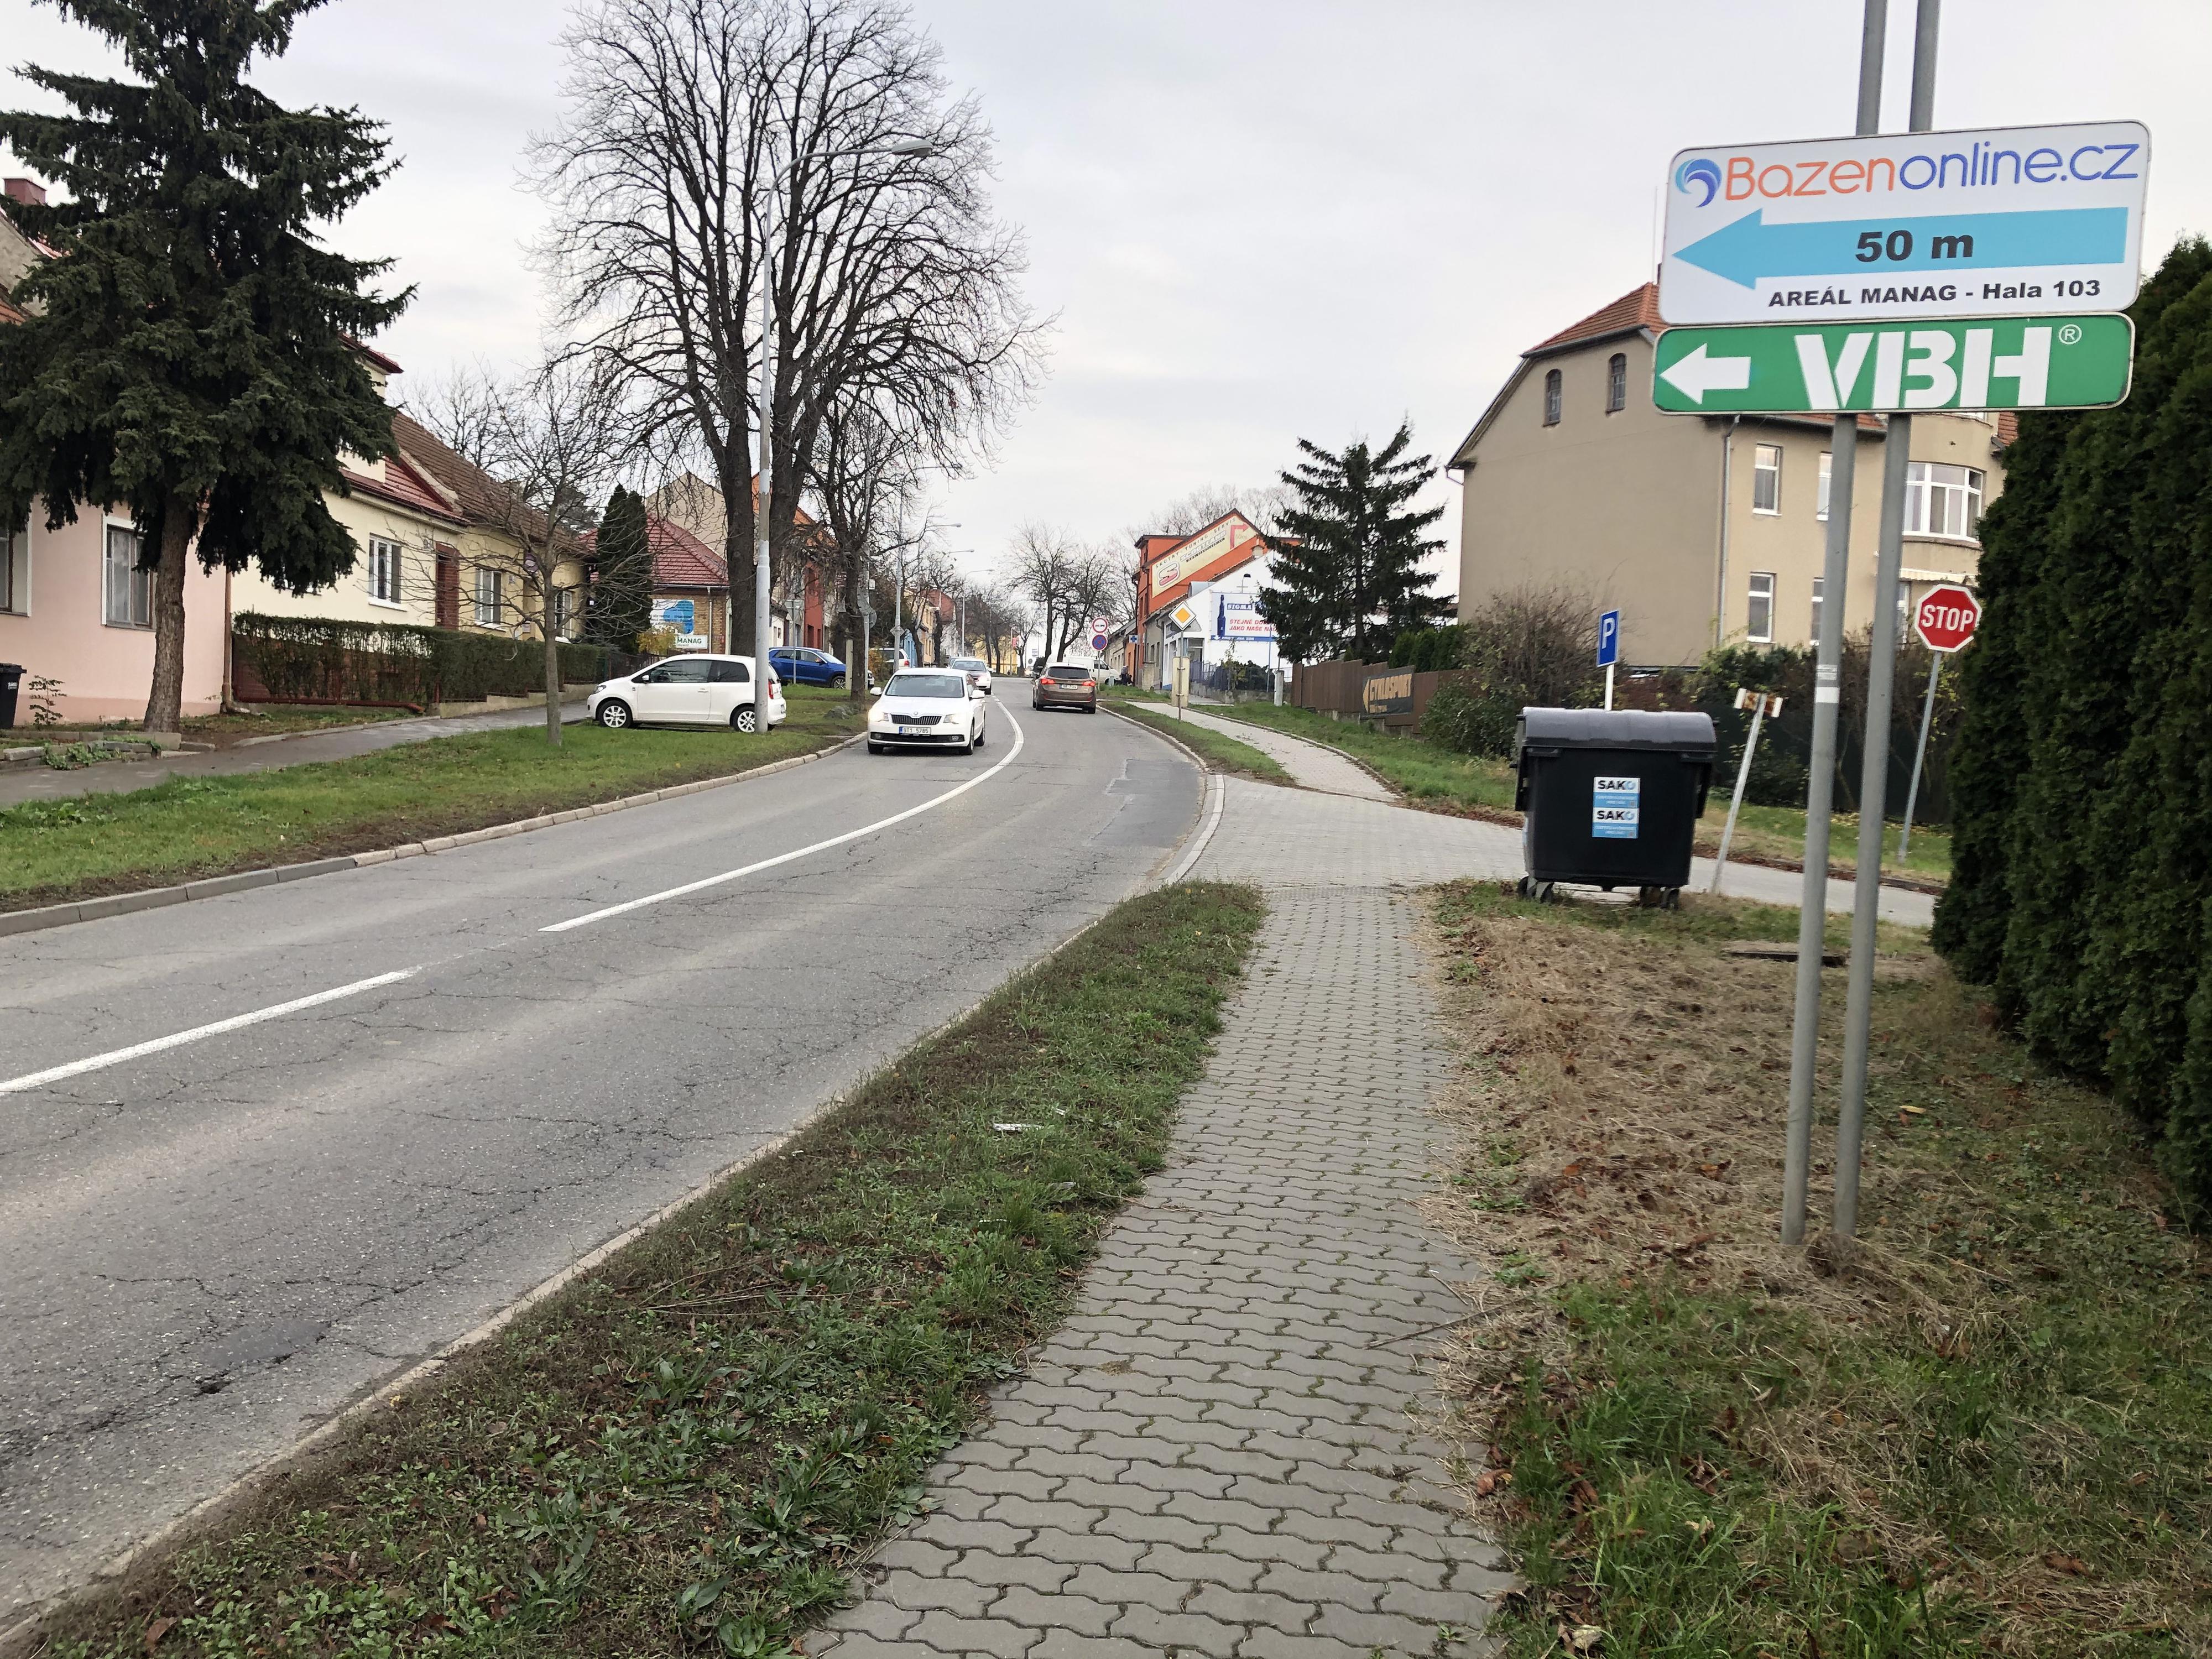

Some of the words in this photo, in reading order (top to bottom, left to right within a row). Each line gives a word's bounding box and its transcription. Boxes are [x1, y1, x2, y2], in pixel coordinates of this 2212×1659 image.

[1725, 140, 2140, 201] Bazenonline.cz
[1855, 229, 1913, 263] 50
[1931, 234, 1974, 260] m
[1768, 285, 1852, 308] AREÁL
[1860, 285, 1957, 304] MANAG
[1983, 281, 2042, 300] Hala
[2052, 279, 2101, 298] 103
[1794, 326, 2052, 410] VBH
[1155, 551, 1180, 568] SKUTRY
[1185, 535, 1208, 551] TUNING
[1213, 518, 1236, 534] SERVIS
[1601, 617, 1615, 649] P
[1921, 604, 1974, 632] STOP
[1597, 780, 1636, 790] SAKO
[1597, 810, 1635, 821] SAKO
